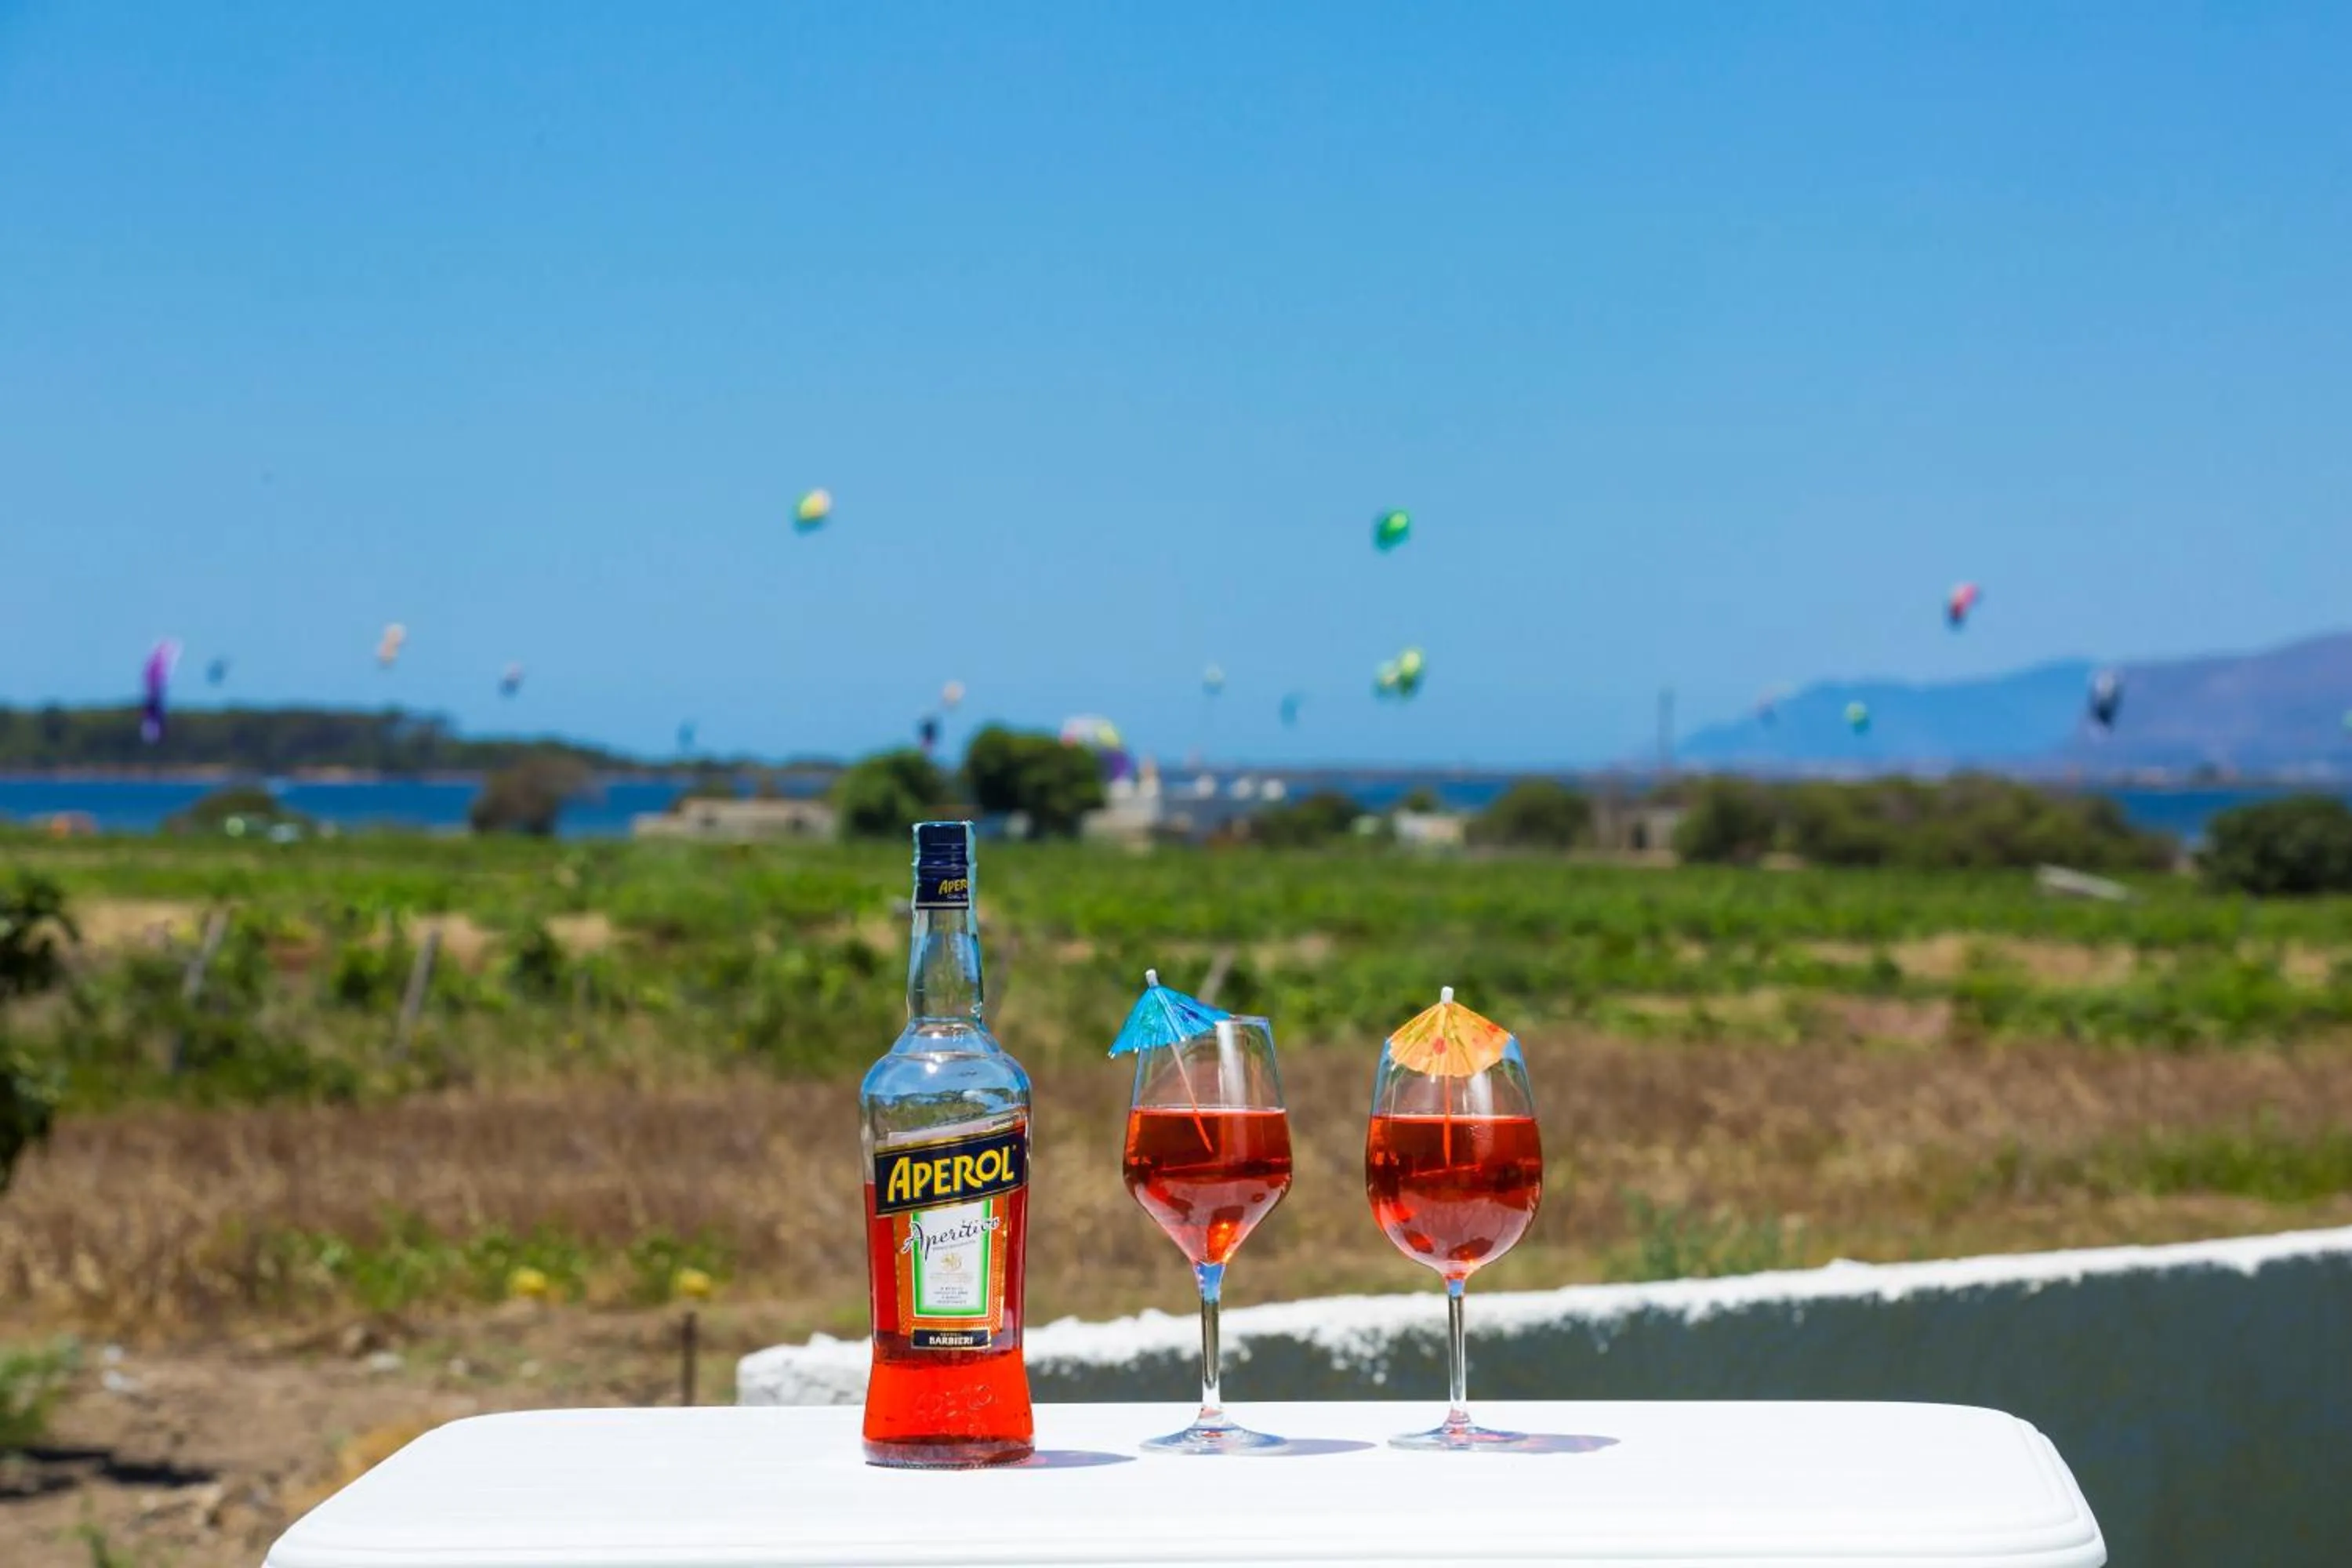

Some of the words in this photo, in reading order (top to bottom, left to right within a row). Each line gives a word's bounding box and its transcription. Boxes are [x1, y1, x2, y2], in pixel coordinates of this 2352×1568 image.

[887, 1146, 1014, 1203] APEROL
[902, 1218, 999, 1261] Aperitivo
[929, 1336, 973, 1345] BARBIERI
